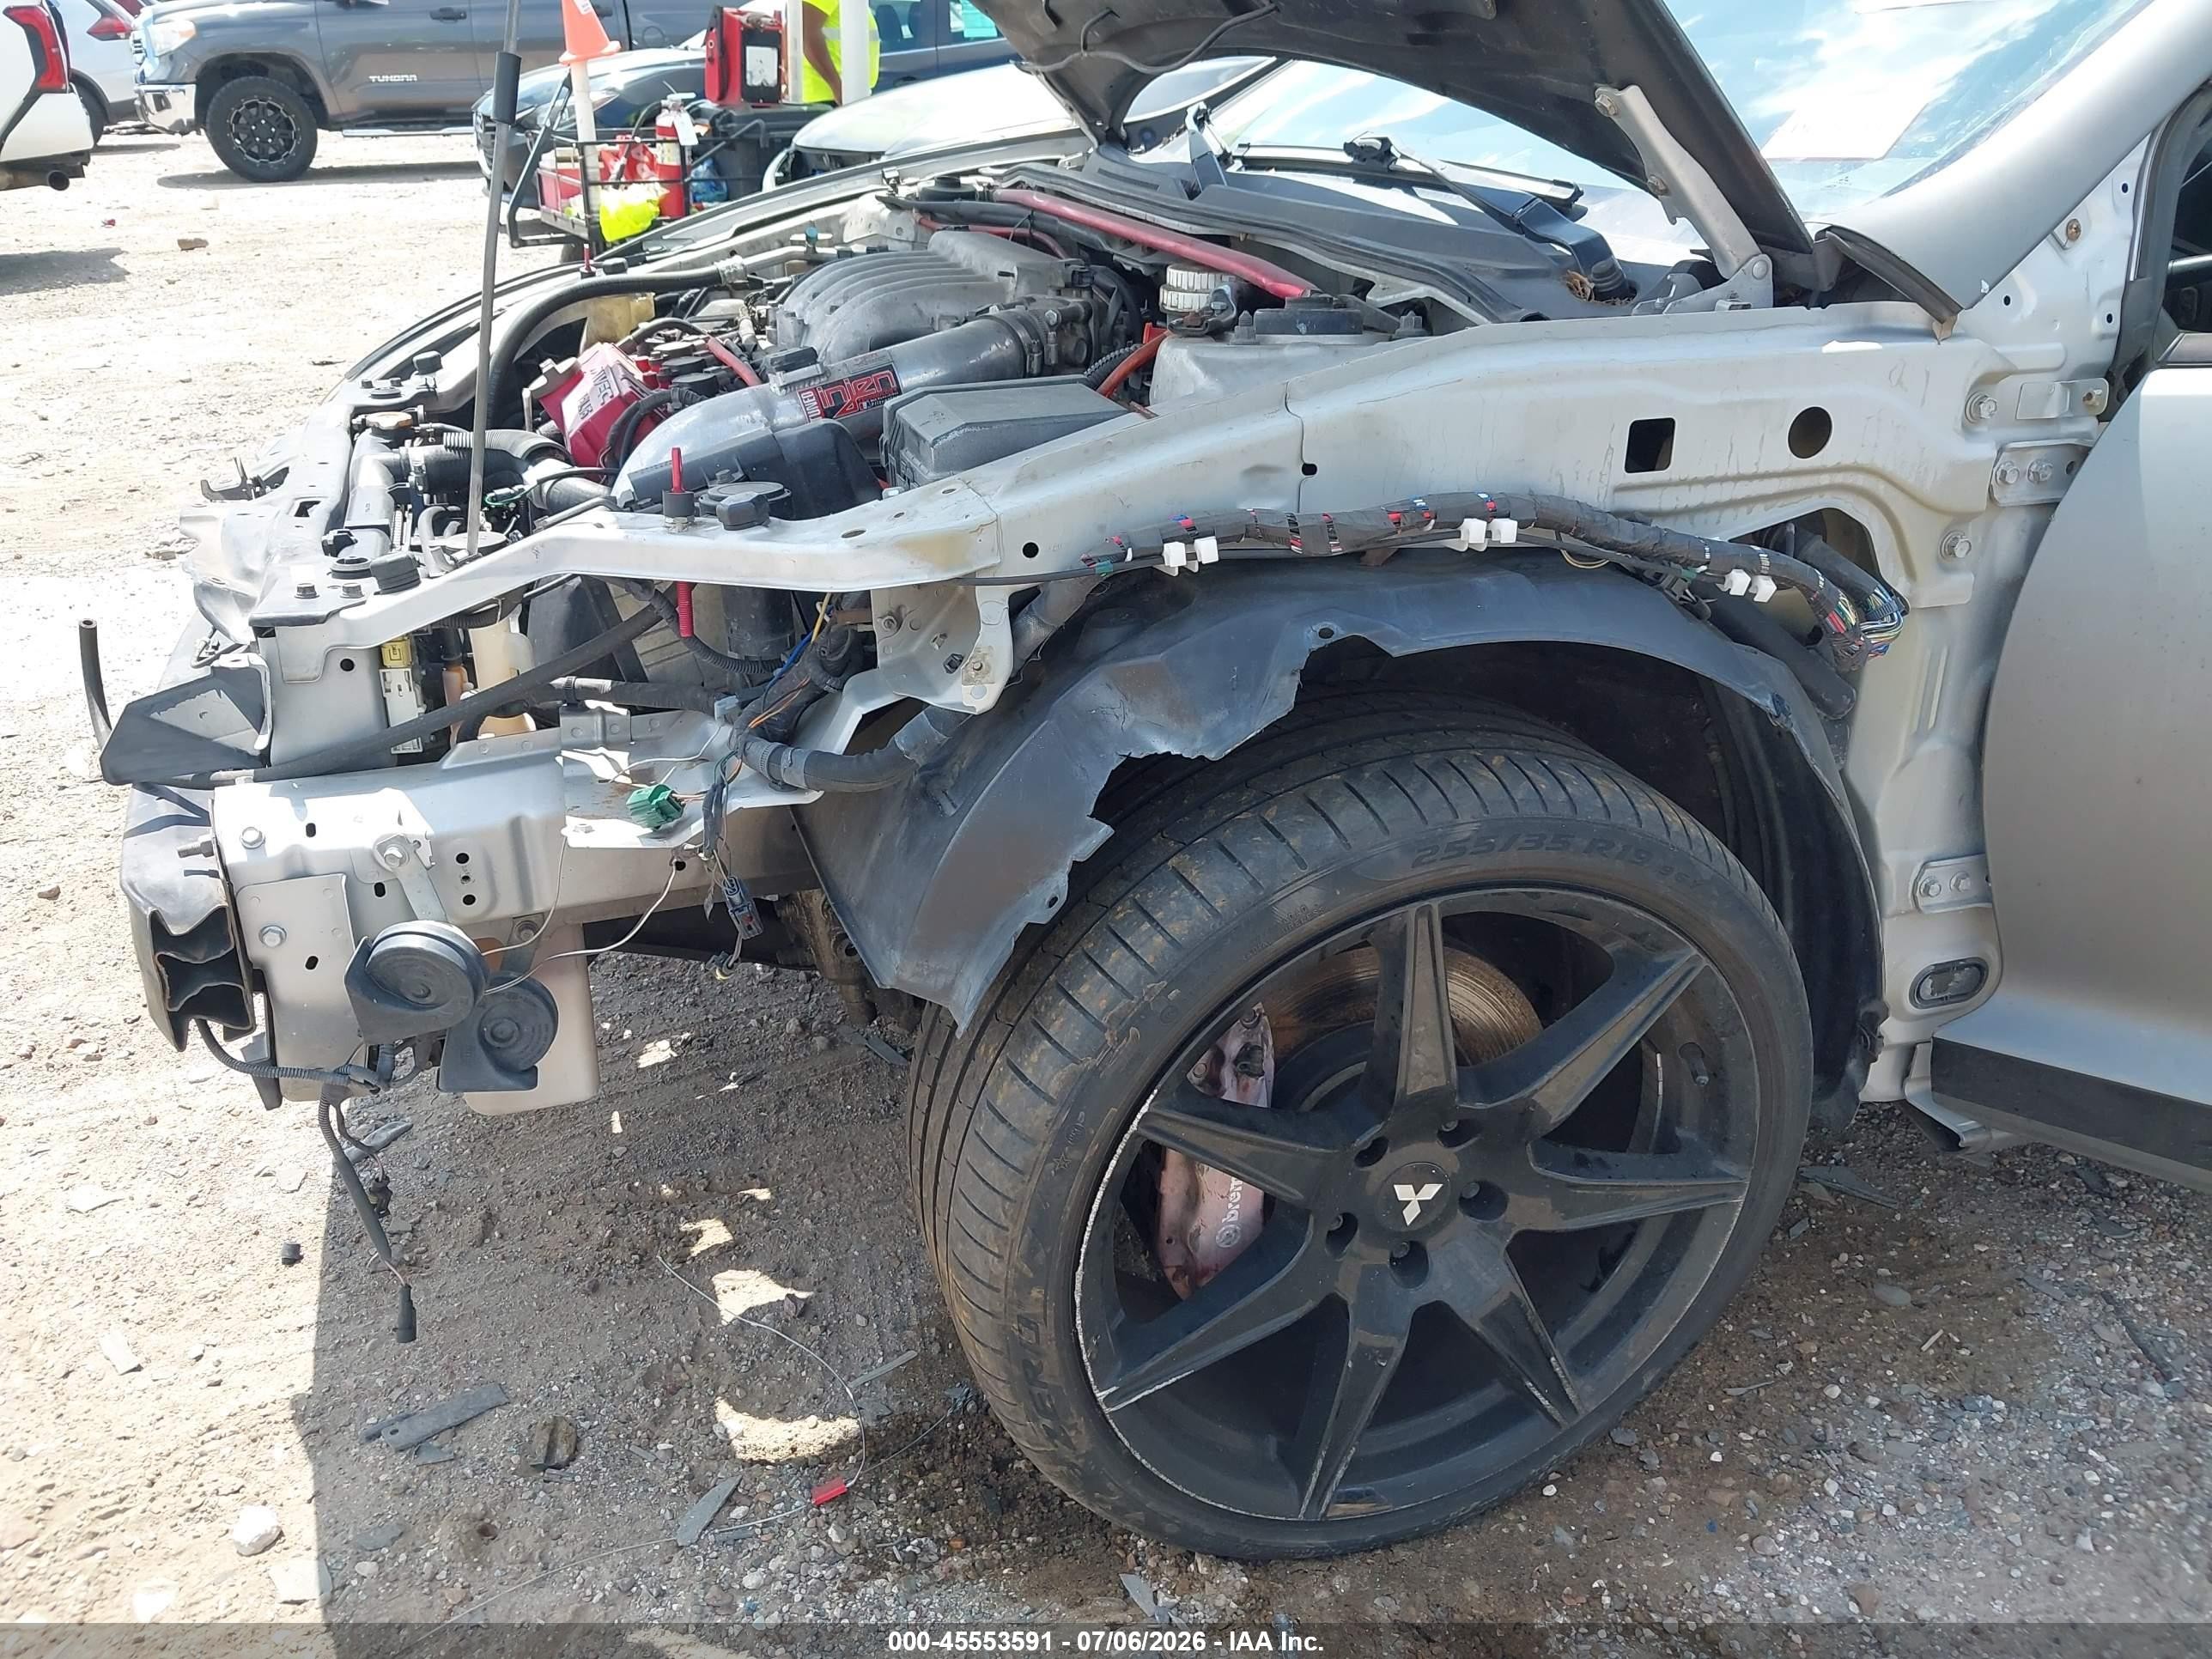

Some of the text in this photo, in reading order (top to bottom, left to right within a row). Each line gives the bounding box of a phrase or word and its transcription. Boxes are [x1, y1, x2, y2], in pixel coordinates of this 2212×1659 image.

[368, 74, 418, 83] TUNDRA
[800, 390, 824, 420] TUNED
[816, 369, 898, 419] injen
[1412, 831, 1577, 868] 255/35
